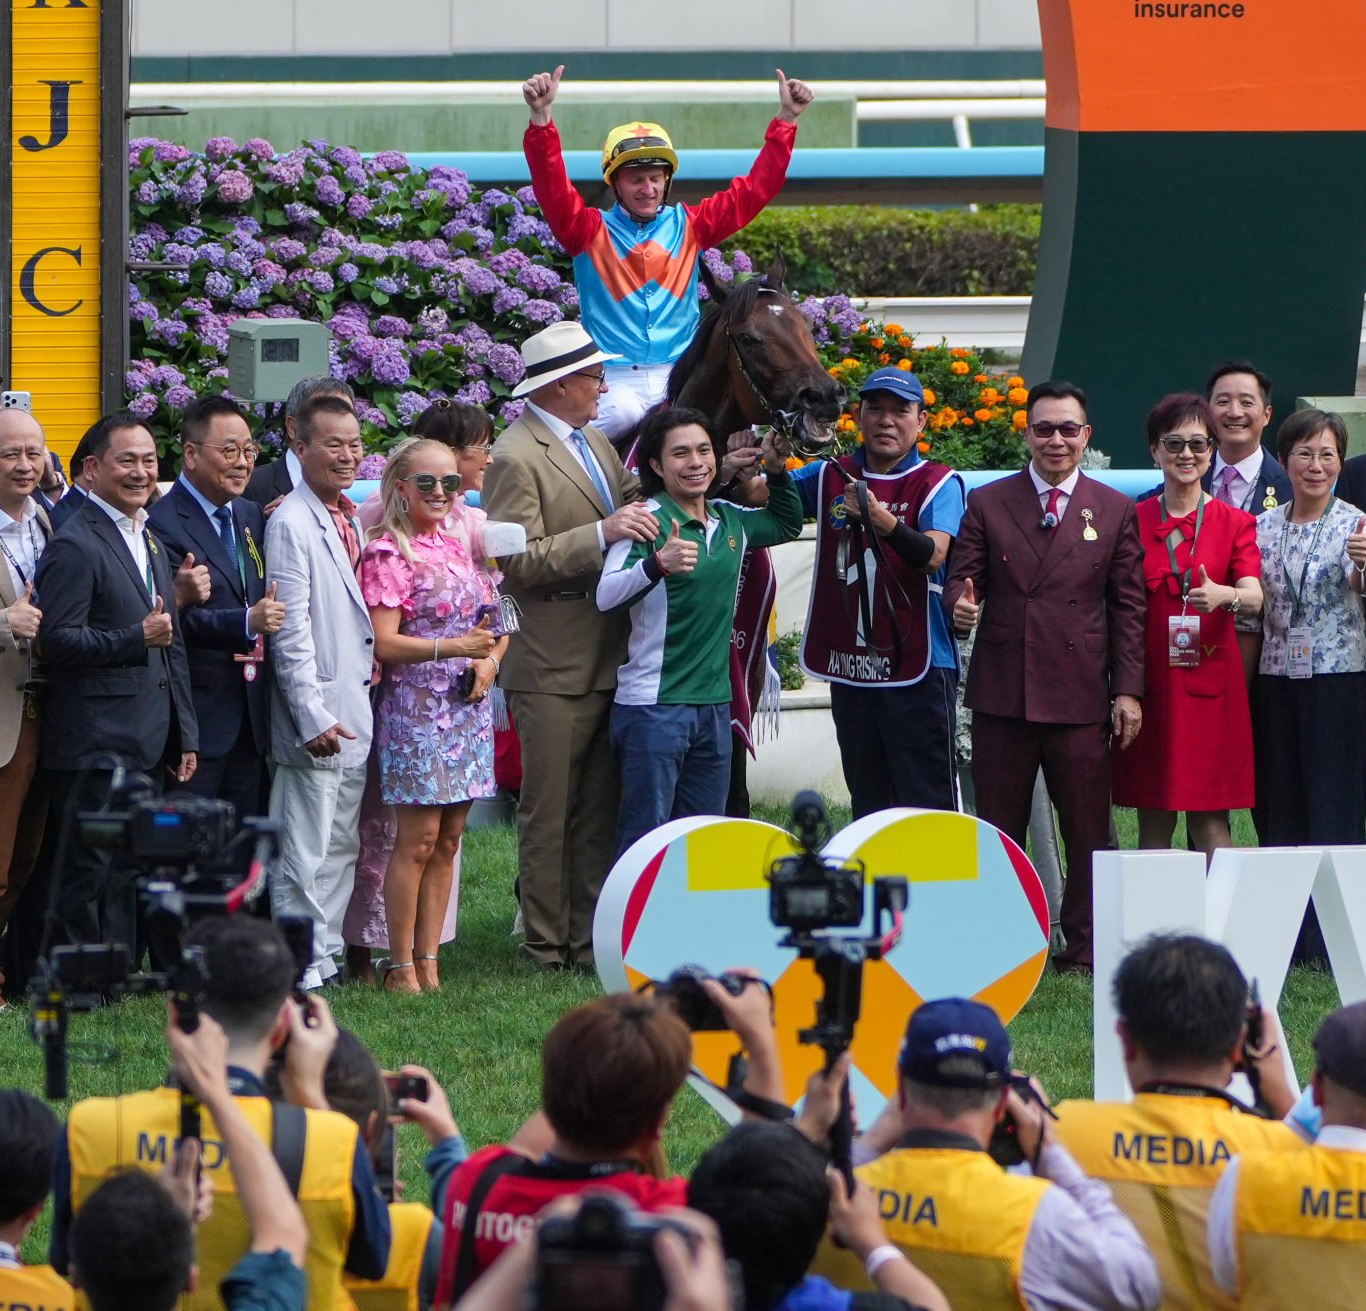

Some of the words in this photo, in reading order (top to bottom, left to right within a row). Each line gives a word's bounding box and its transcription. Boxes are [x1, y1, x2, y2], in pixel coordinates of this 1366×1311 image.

[1135, 2, 1246, 19] insurance
[1114, 1132, 1233, 1167] MEDIA
[878, 1189, 938, 1227] DIA
